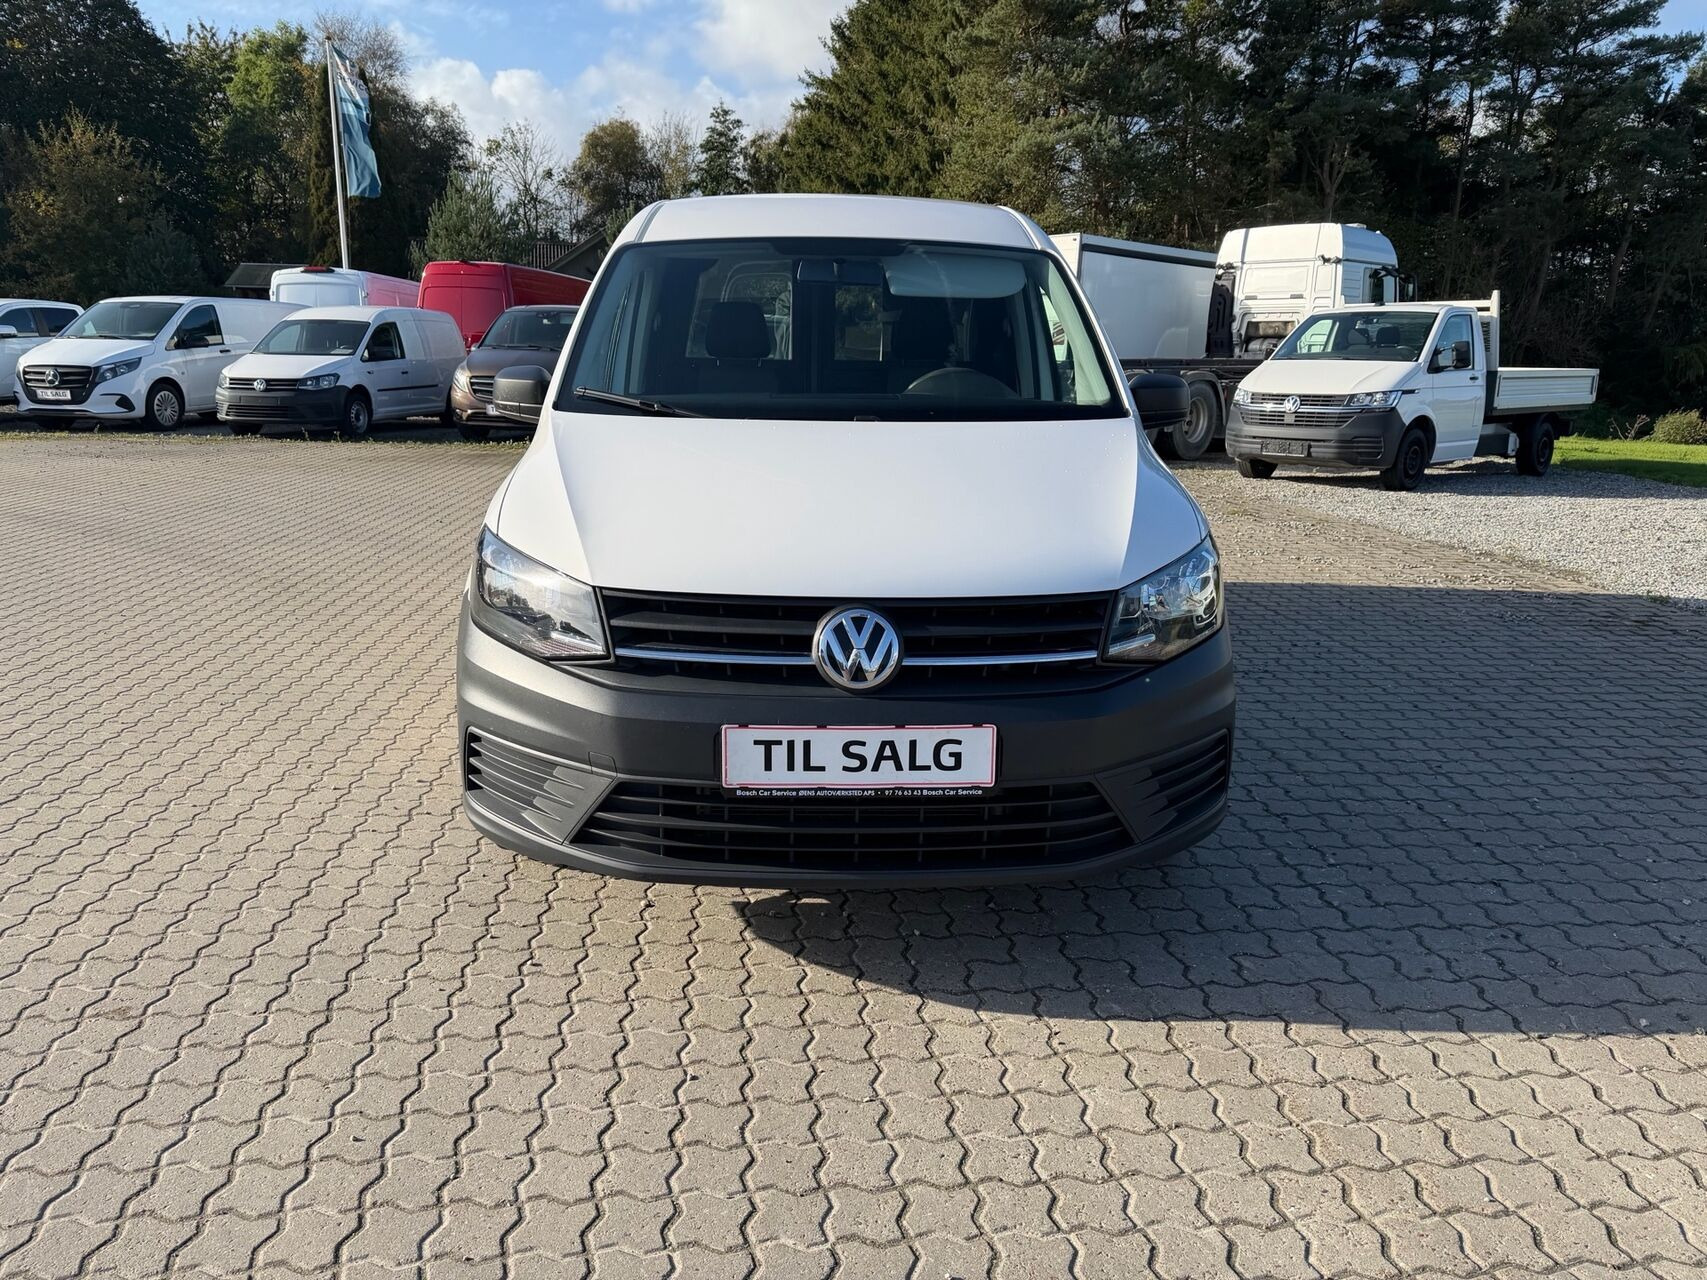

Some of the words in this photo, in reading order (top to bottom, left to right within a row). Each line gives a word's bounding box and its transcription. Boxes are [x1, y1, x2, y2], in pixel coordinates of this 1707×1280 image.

[753, 739, 826, 772] TIL
[841, 738, 963, 773] SALG
[944, 788, 956, 796] Car
[957, 788, 983, 796] Service
